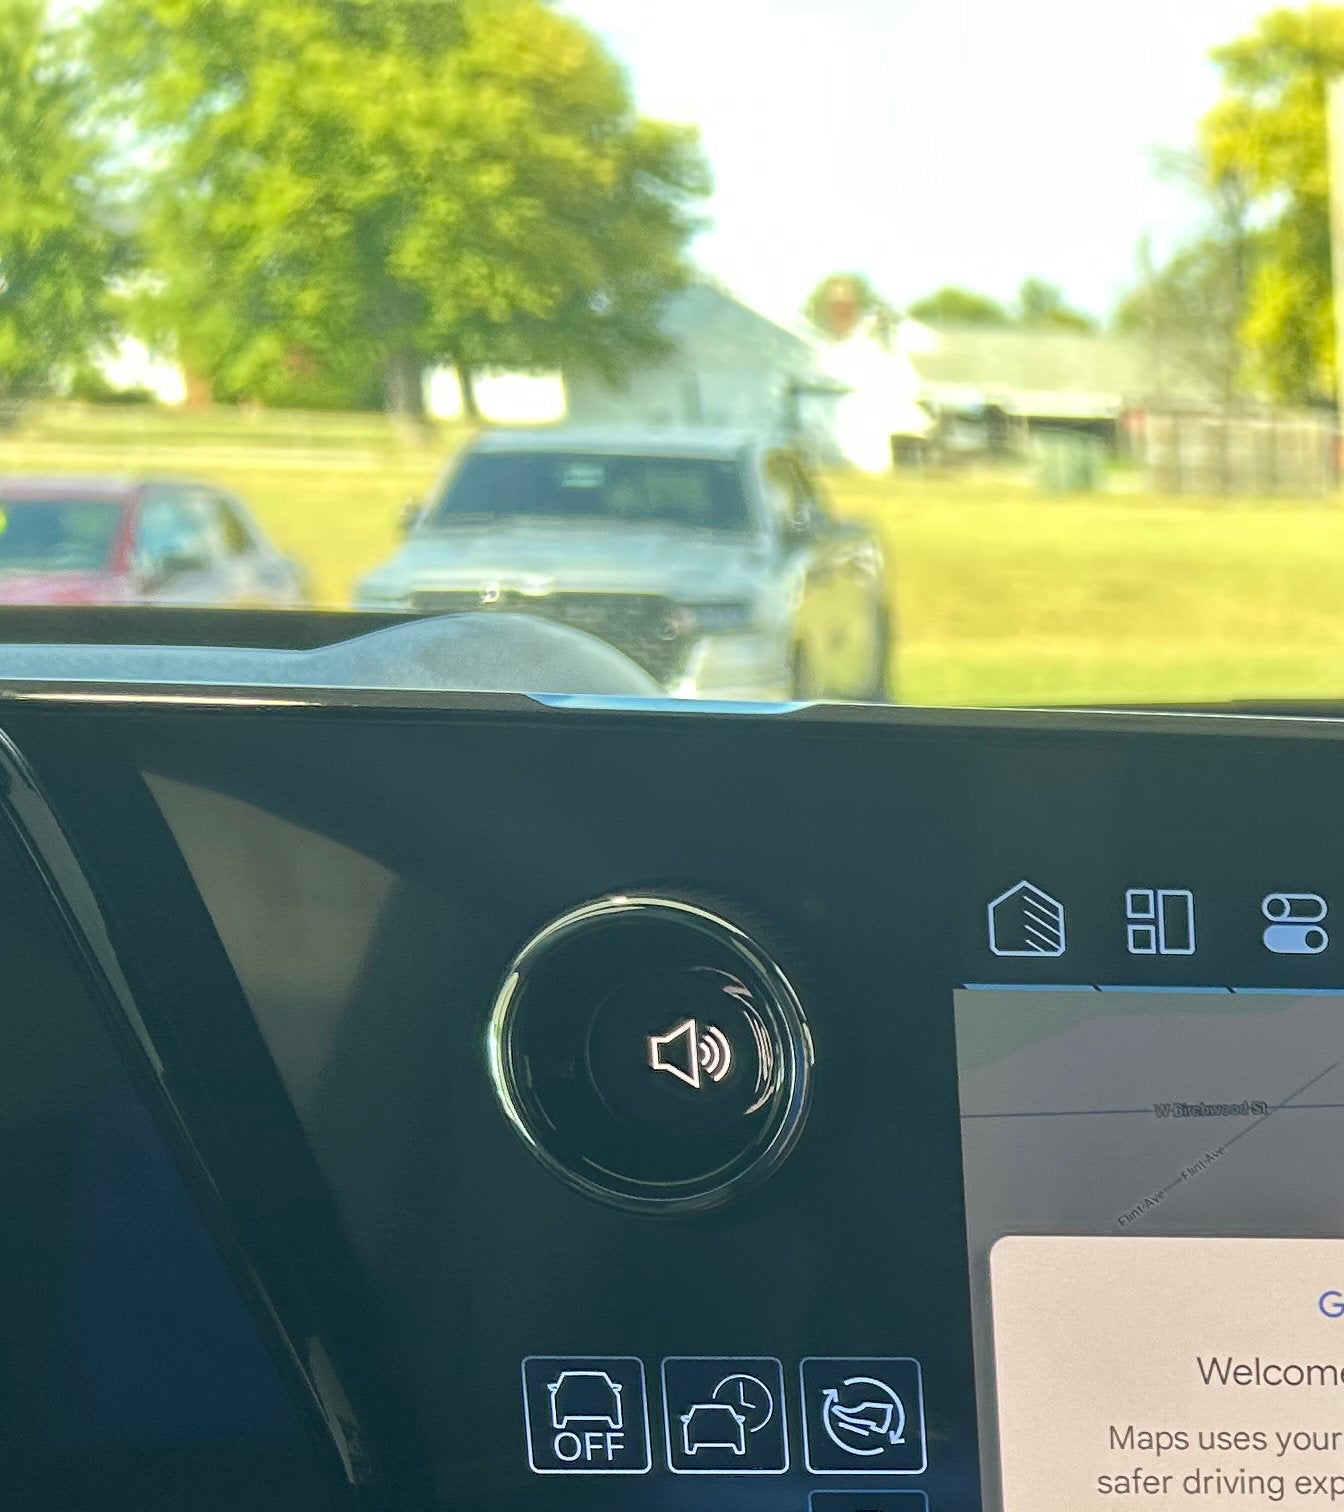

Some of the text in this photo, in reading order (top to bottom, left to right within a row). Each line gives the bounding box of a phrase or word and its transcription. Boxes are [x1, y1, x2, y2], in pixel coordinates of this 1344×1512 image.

[553, 1430, 626, 1463] OFF
[1110, 1426, 1191, 1458] Maps
[1199, 1432, 1269, 1452] uses
[1276, 1432, 1344, 1459] your
[1098, 1467, 1175, 1496] safer
[1183, 1468, 1286, 1503] driving
